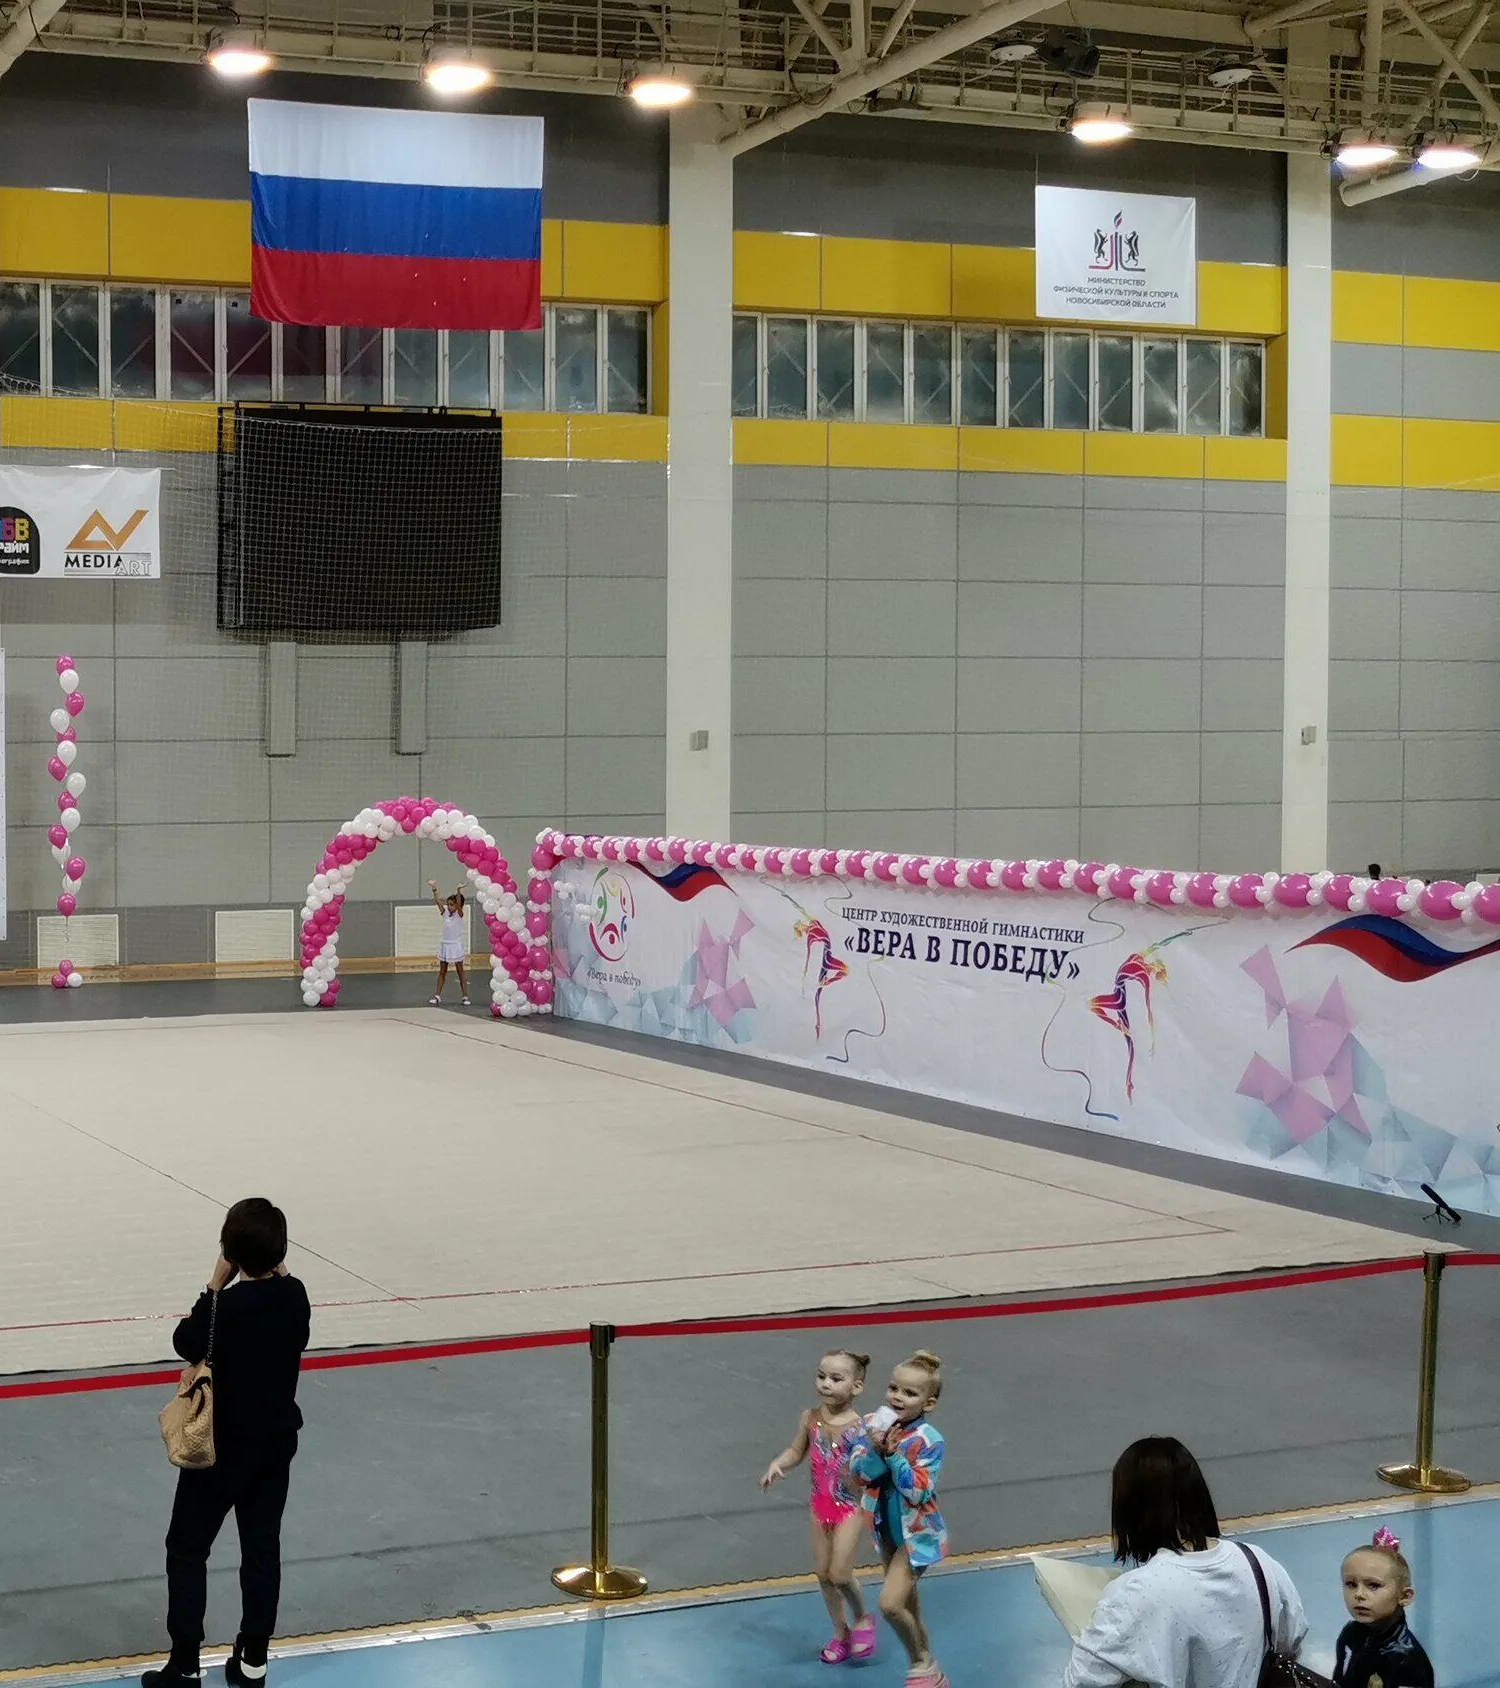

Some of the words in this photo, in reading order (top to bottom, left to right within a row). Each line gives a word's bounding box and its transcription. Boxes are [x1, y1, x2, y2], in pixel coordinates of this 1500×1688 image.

[1087, 277, 1146, 287] МИНИСТЕРСТВО
[1053, 285, 1103, 295] ФИЗИЧЕСКОЙ
[1104, 288, 1142, 297] КУЛЬТУРЫ
[1149, 291, 1179, 299] СПОРТА
[1066, 297, 1131, 307] НОВОСИБИРСКОЙ
[1132, 300, 1166, 308] ОБЛАСТИ
[64, 554, 123, 568] MEDIA
[115, 560, 152, 576] ART
[841, 907, 878, 922] ЦЕНТР
[880, 910, 989, 934] ХУДОЖЕСТВЕННОЙ
[991, 922, 1085, 944] ГИМНАСТИКИ
[844, 927, 917, 961] «ВЕРА
[925, 935, 941, 962] В
[950, 938, 1081, 983] ПОБЕДУ»
